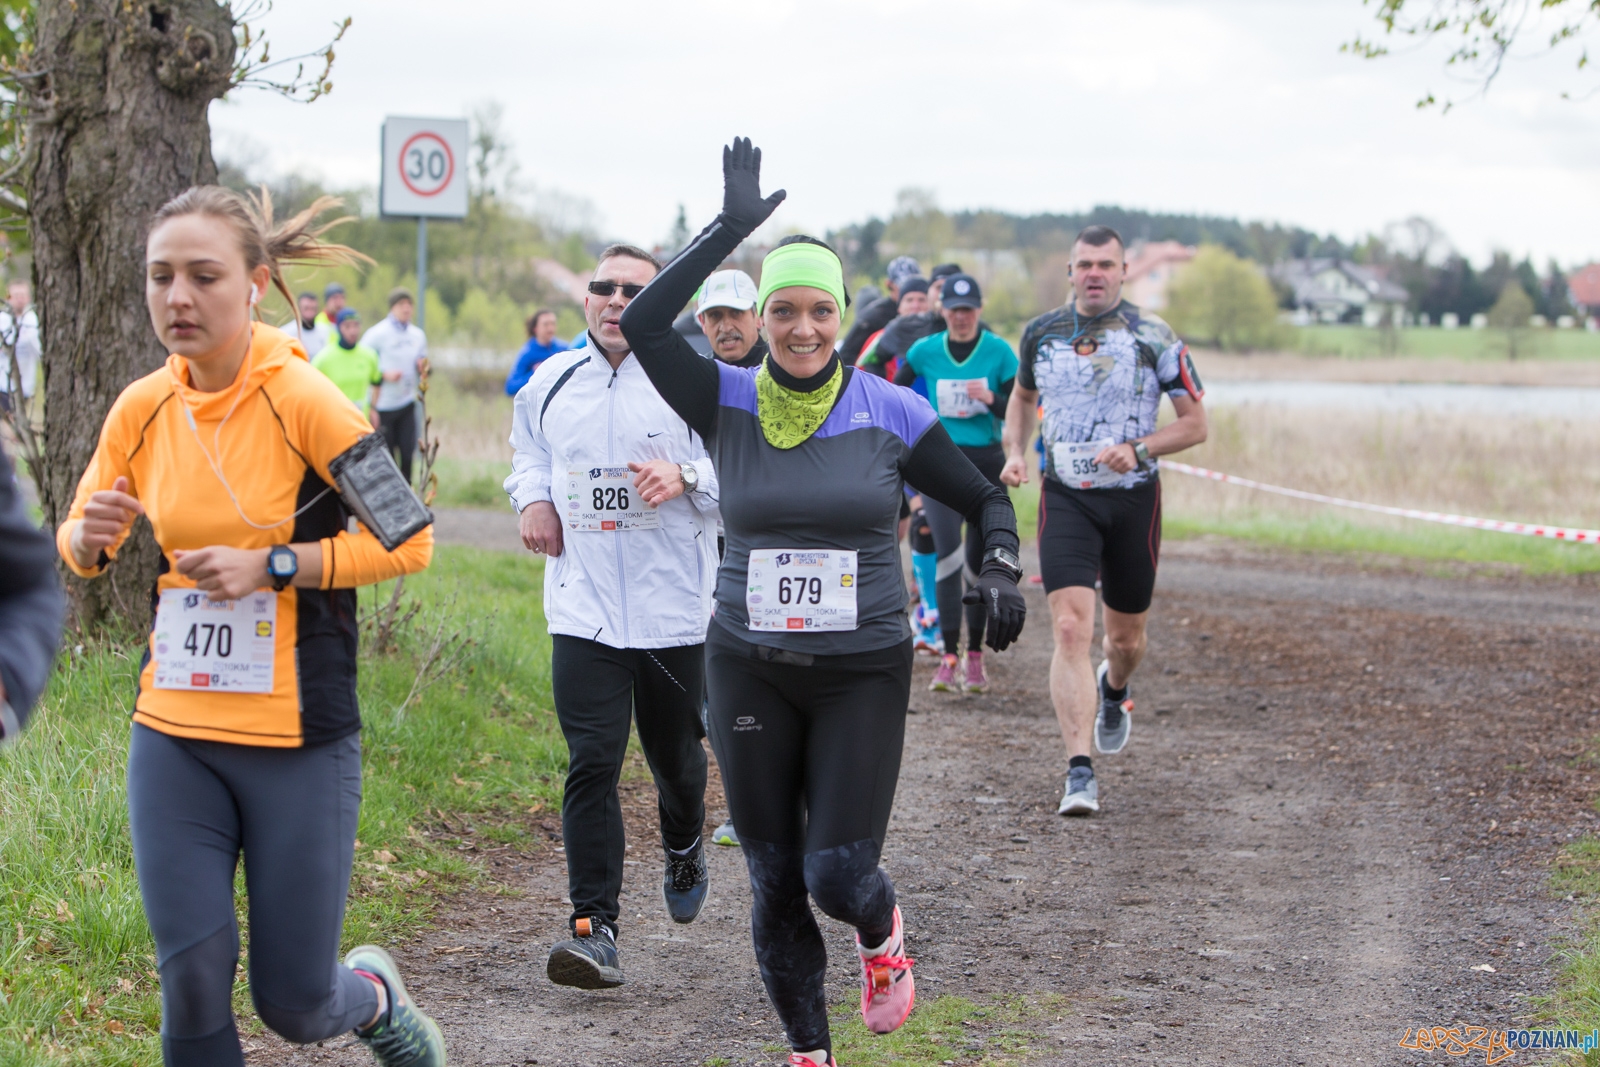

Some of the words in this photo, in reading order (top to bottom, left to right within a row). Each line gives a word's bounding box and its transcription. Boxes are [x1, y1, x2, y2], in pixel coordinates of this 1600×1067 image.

[408, 149, 445, 181] 30
[1072, 458, 1099, 475] 539
[592, 487, 629, 511] 826
[779, 576, 822, 605] 679
[764, 608, 781, 616] 5KM
[816, 608, 837, 616] 10KM
[184, 623, 233, 658] 470
